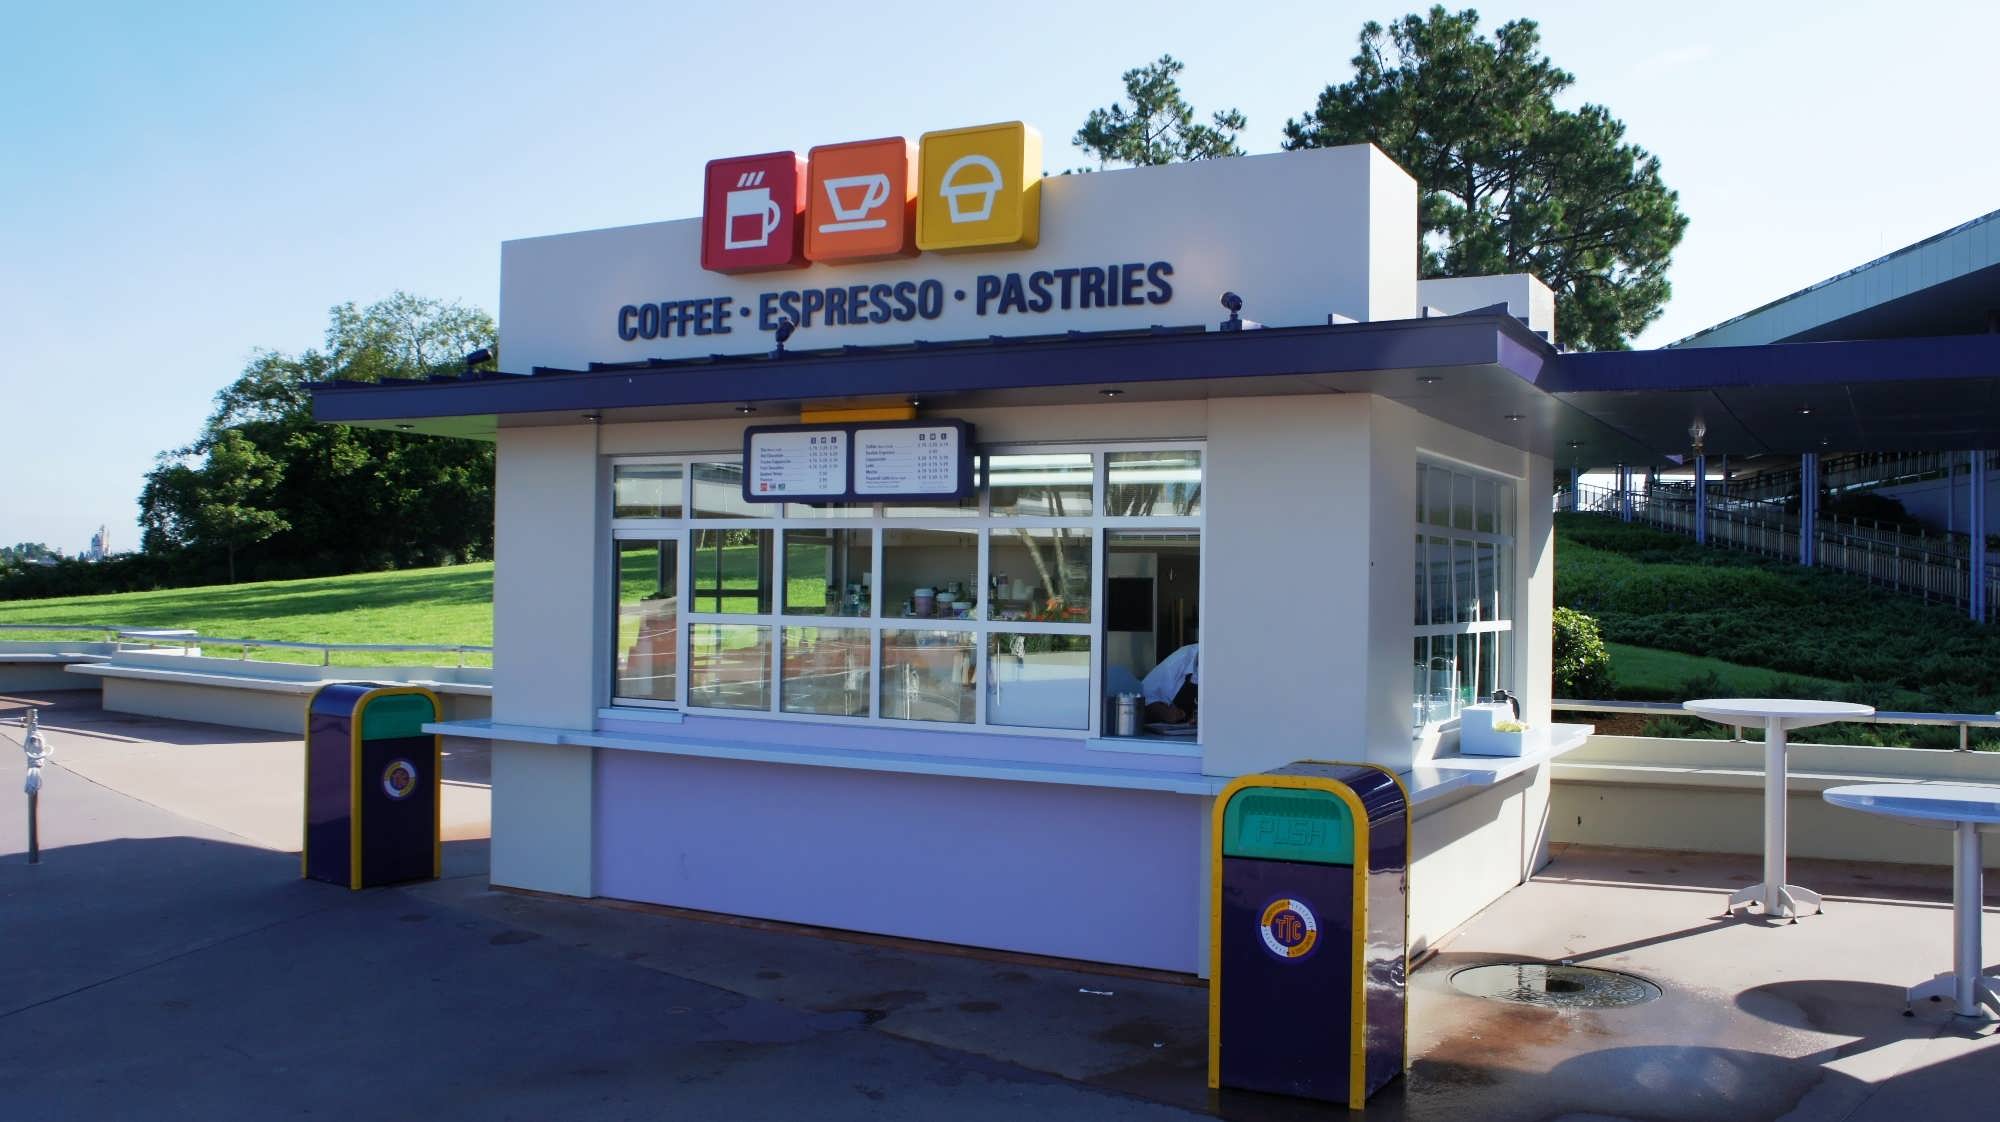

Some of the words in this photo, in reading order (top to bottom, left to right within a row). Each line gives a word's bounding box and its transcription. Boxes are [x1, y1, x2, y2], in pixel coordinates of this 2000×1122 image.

[617, 297, 733, 341] COFFEE
[759, 279, 943, 331] ESPRESSO
[976, 261, 1174, 316] PASTRIES
[1256, 819, 1328, 848] PUSH
[1275, 914, 1302, 943] TTC
